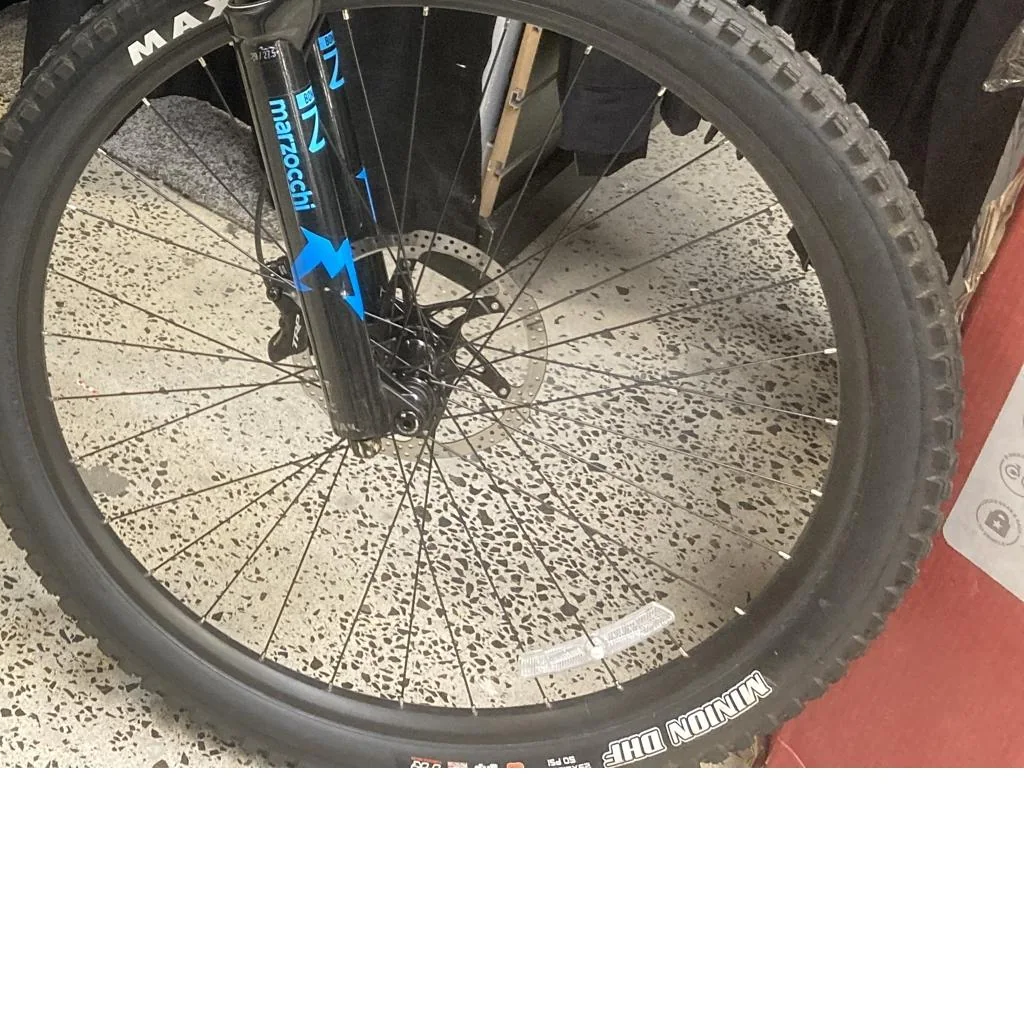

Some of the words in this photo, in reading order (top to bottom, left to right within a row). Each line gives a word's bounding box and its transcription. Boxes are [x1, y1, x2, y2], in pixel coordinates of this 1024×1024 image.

[268, 98, 317, 212] marzocchi
[291, 314, 302, 349] TRP
[665, 669, 773, 747] MINION
[547, 758, 562, 767] PSI
[602, 726, 668, 768] DHF
